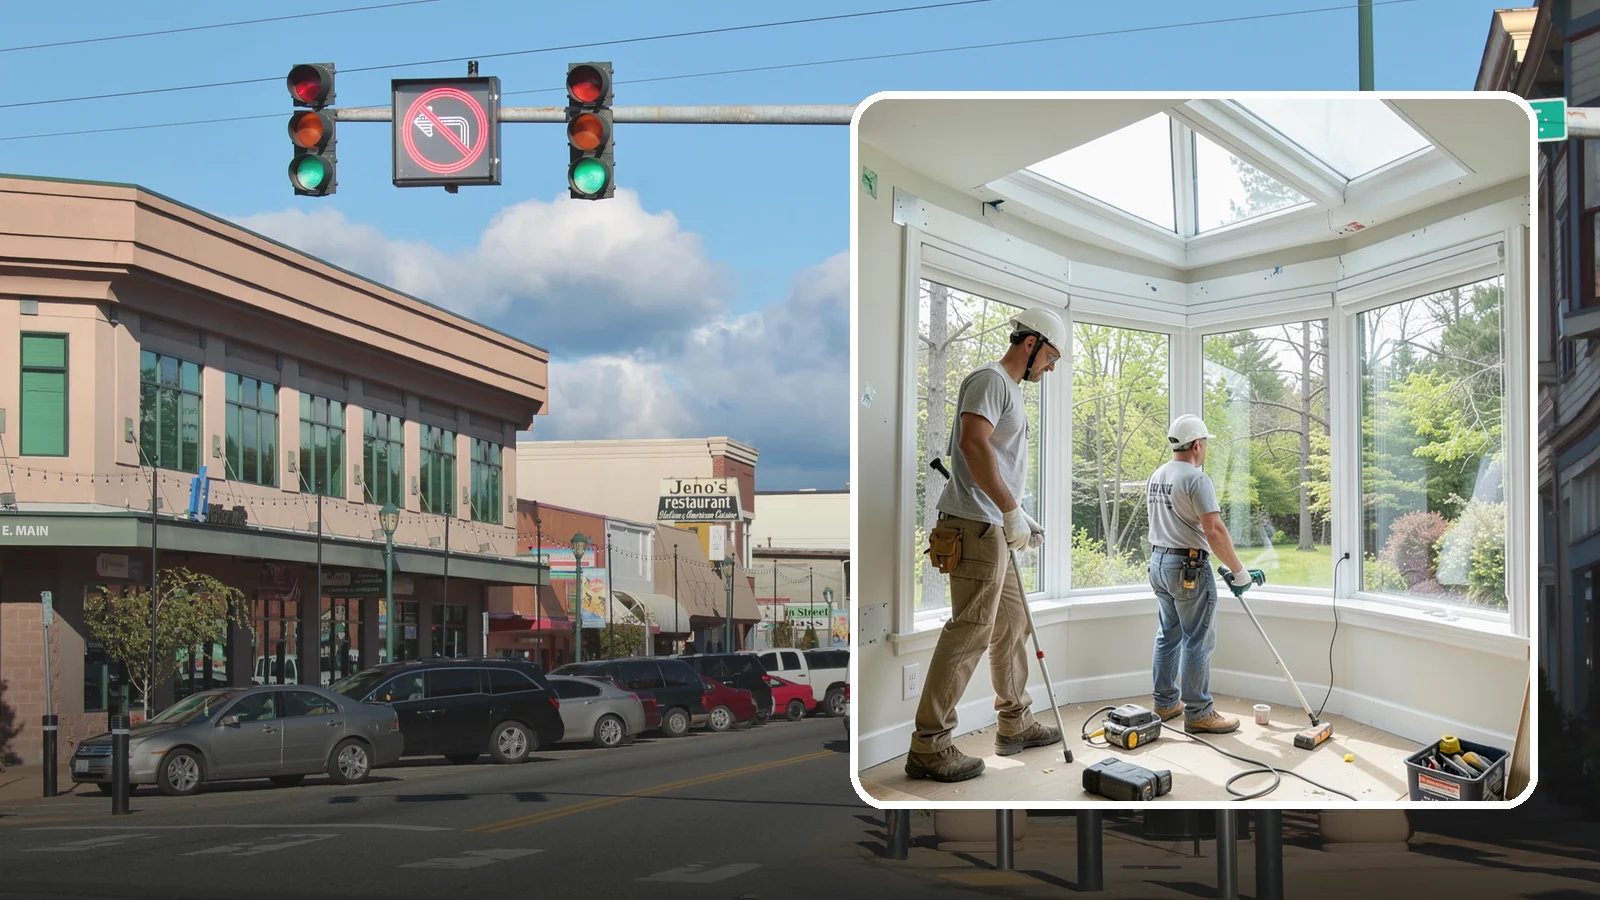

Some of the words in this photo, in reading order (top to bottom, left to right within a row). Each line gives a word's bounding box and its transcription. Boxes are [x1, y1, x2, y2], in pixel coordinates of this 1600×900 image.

[670, 480, 727, 494] Jeno's
[665, 497, 731, 509] restaurant
[658, 510, 681, 520] Italian
[686, 510, 715, 519] American
[715, 510, 738, 519] Cuisine
[2, 526, 13, 536] E.
[15, 526, 49, 536] MAIN
[797, 608, 828, 616] Street
[790, 619, 824, 627] lass
